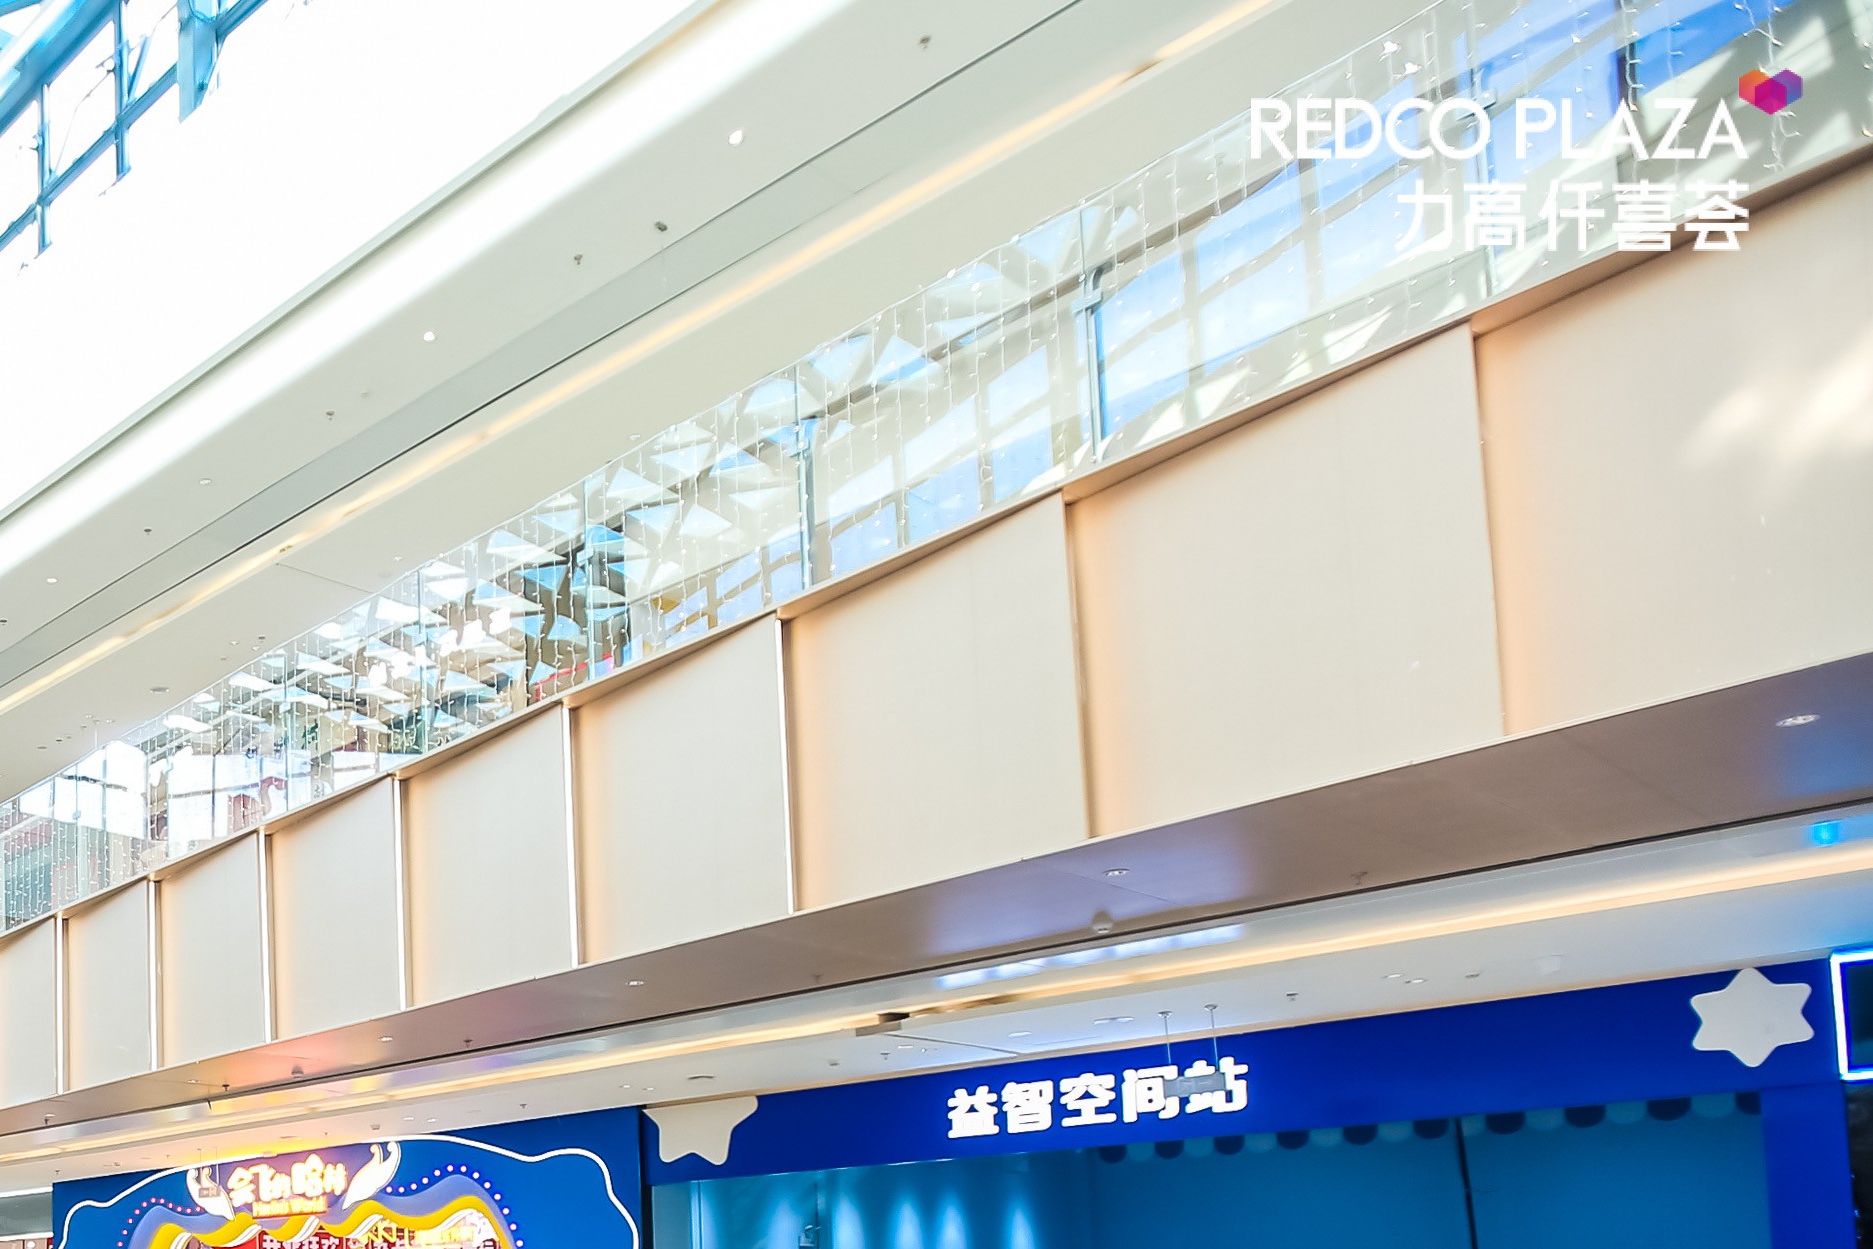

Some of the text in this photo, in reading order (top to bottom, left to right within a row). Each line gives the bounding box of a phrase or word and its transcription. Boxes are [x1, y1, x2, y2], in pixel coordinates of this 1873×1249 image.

[947, 1056, 1249, 1139] 益智空间站
